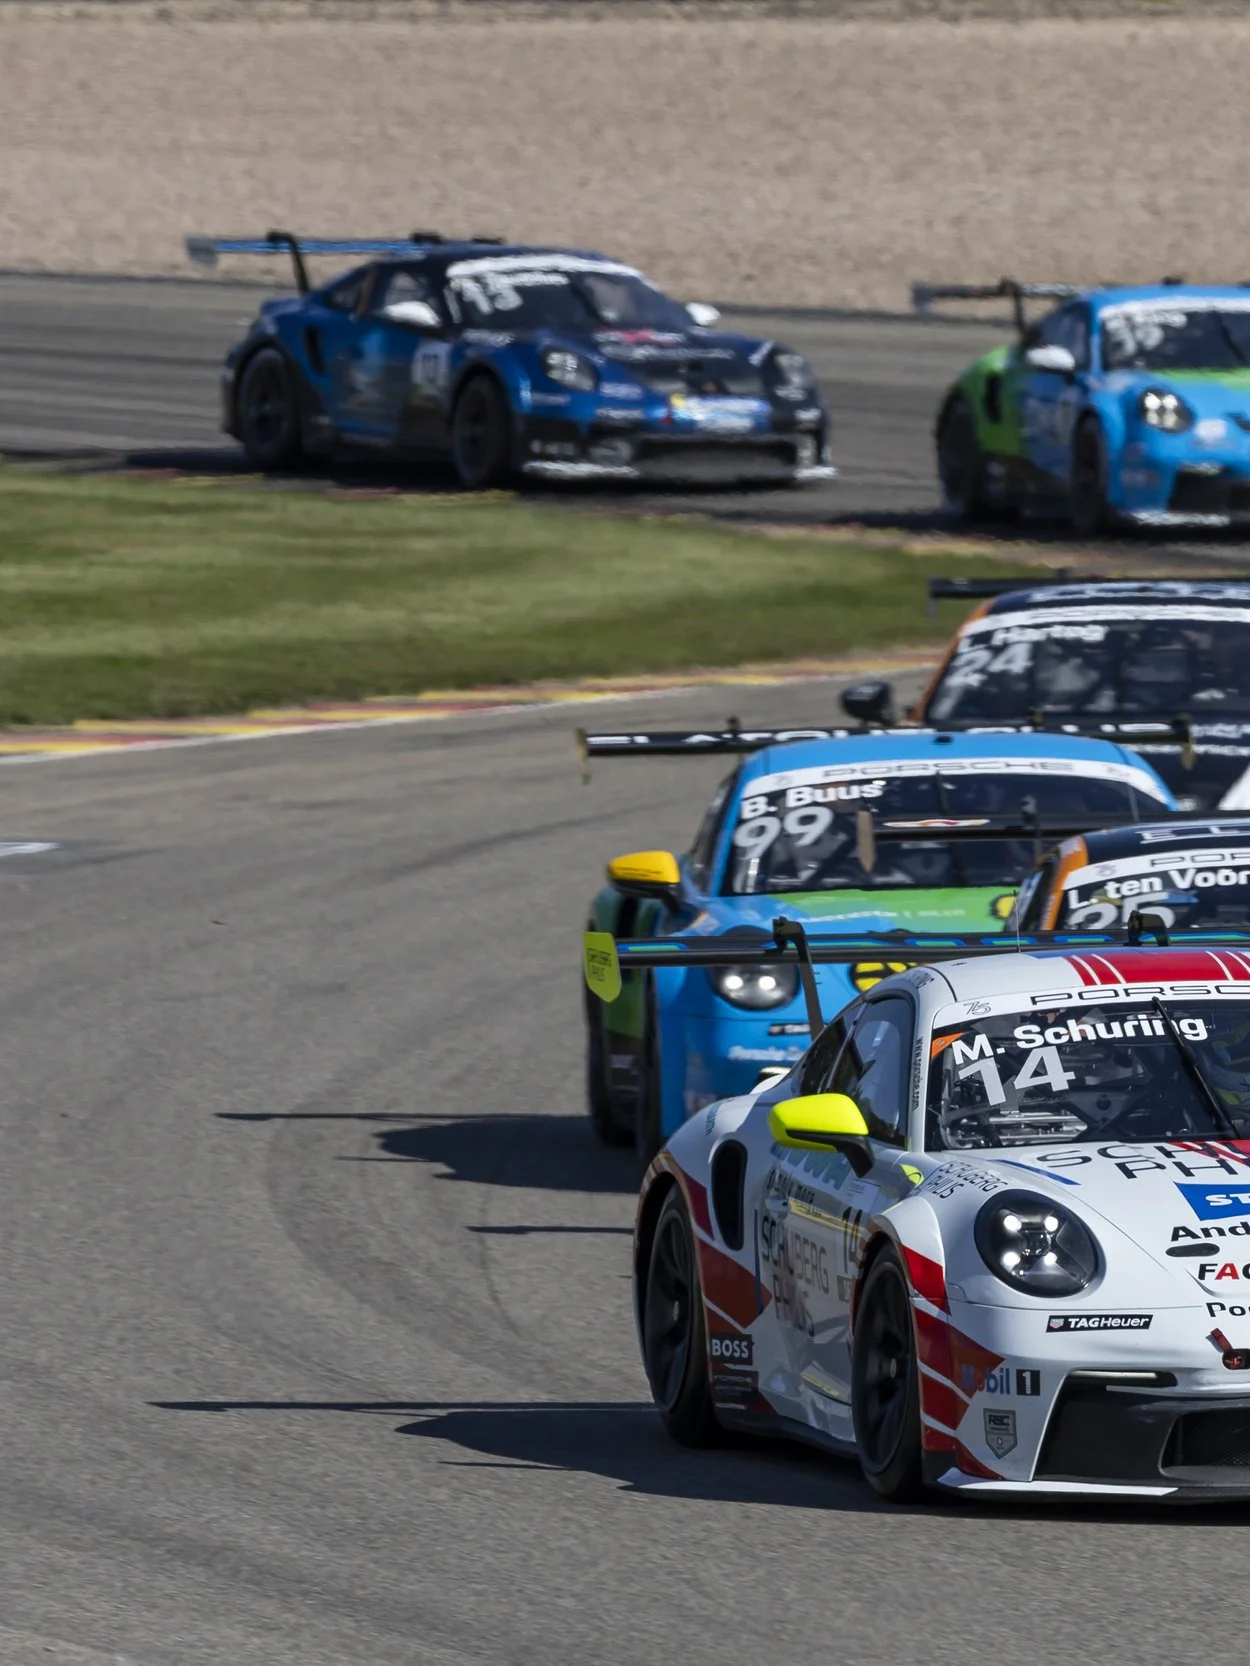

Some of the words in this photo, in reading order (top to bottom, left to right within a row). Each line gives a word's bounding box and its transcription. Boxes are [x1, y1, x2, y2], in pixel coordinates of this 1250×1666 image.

[944, 642, 1034, 687] 24
[823, 760, 1074, 778] PORSCHE
[742, 796, 778, 819] B.
[786, 782, 884, 808] Buus
[733, 806, 834, 861] 99
[1068, 890, 1098, 909] L.
[1104, 876, 1163, 899] ten
[951, 1034, 1006, 1065] M.
[1013, 1014, 1208, 1050] Schuring
[957, 1045, 1077, 1106] 14
[938, 1161, 1009, 1193] SCHUBERG
[1067, 1316, 1150, 1329] TAGHeuer
[711, 1338, 750, 1359] BOSS
[1022, 1371, 1034, 1395] 1
